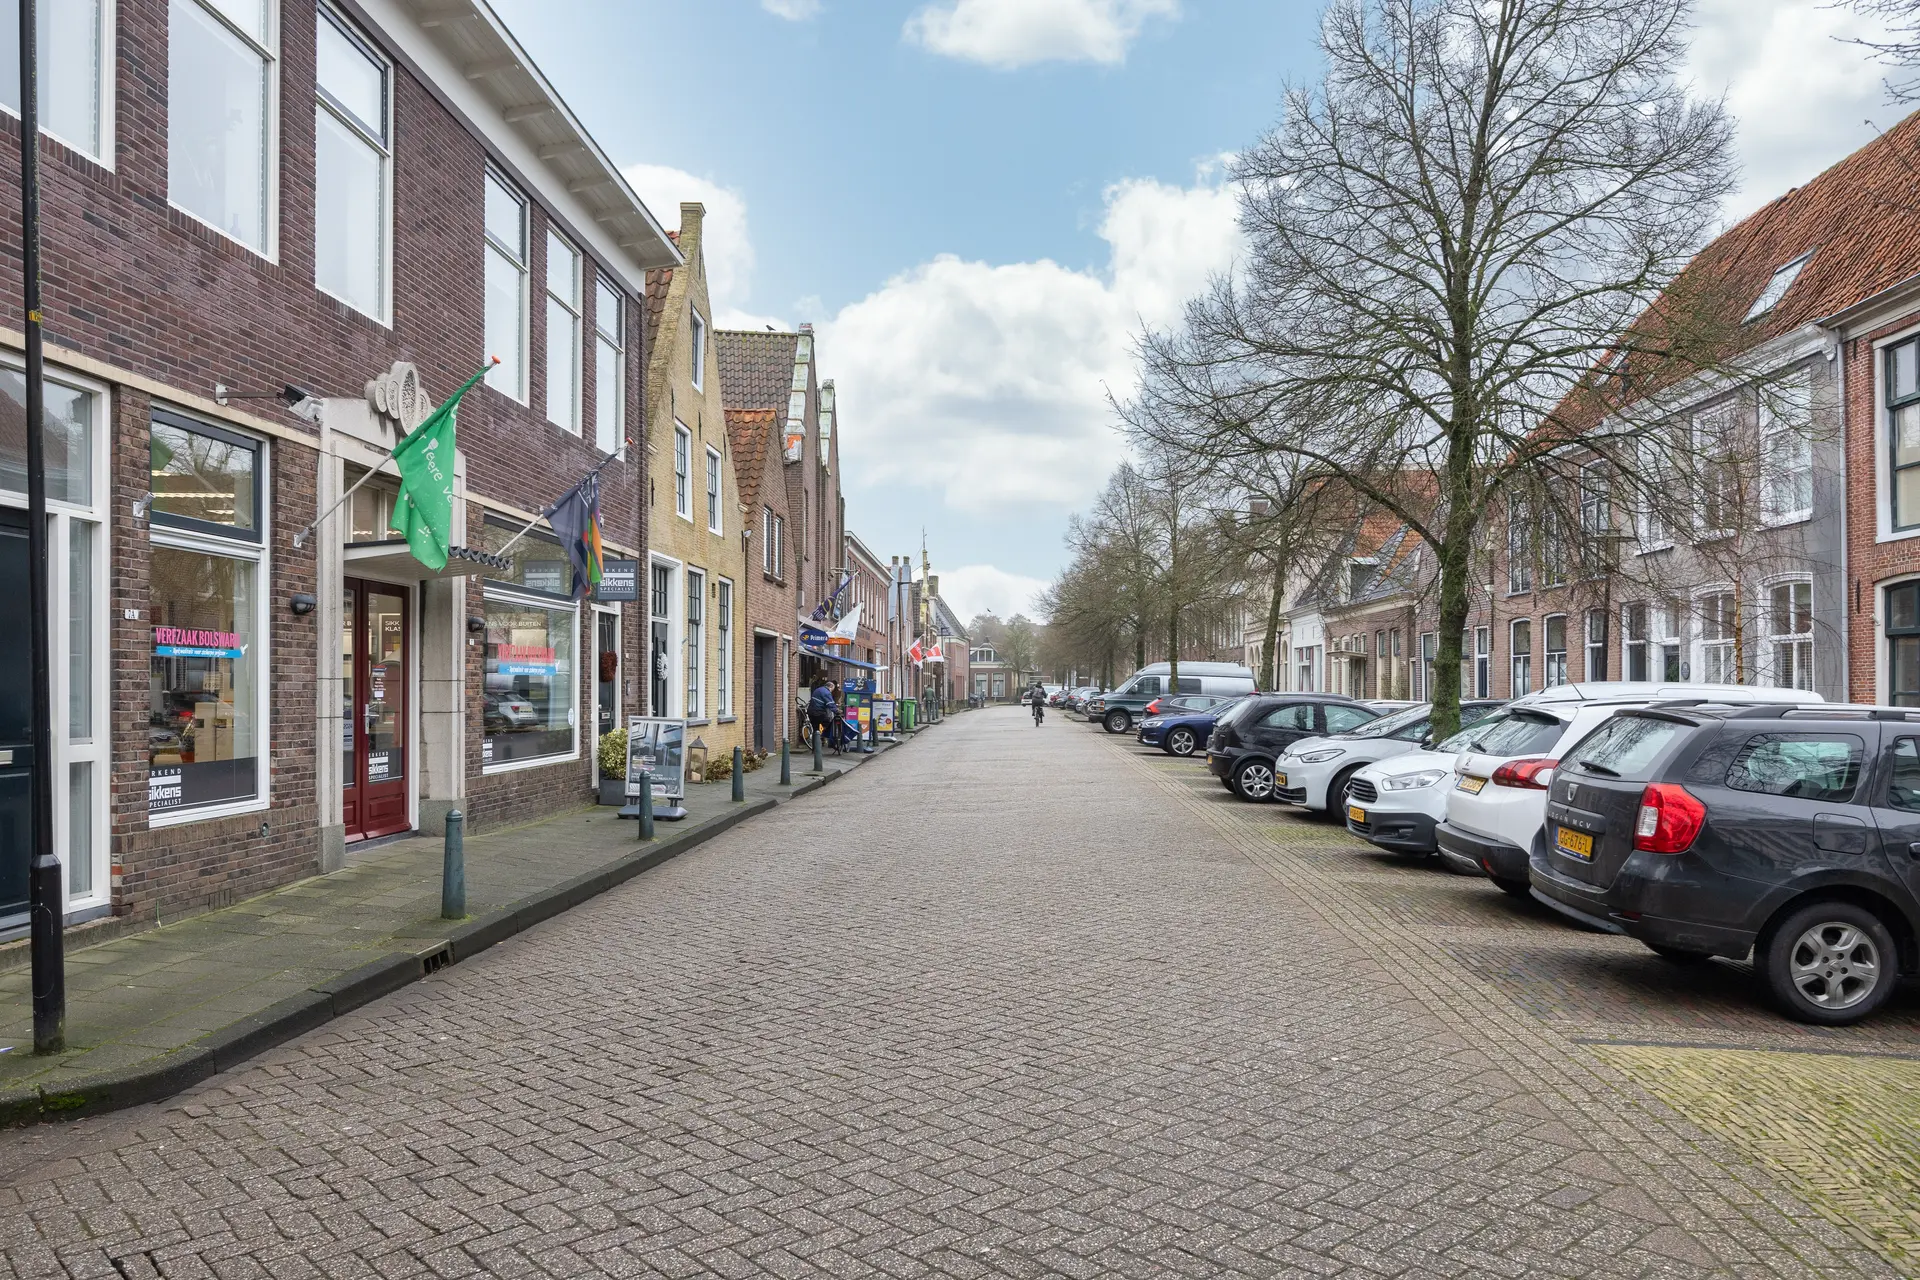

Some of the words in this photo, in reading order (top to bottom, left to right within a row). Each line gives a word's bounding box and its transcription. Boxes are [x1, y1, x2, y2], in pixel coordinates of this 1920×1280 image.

[600, 578, 634, 587] sikkens
[156, 627, 198, 645] VERFZAAK
[199, 631, 241, 648] BOLSWARD
[151, 768, 182, 777] RKEND
[149, 798, 182, 808] PECIALIST
[1548, 812, 1568, 822] LOGAN
[1560, 829, 1589, 853] GG-676-L
